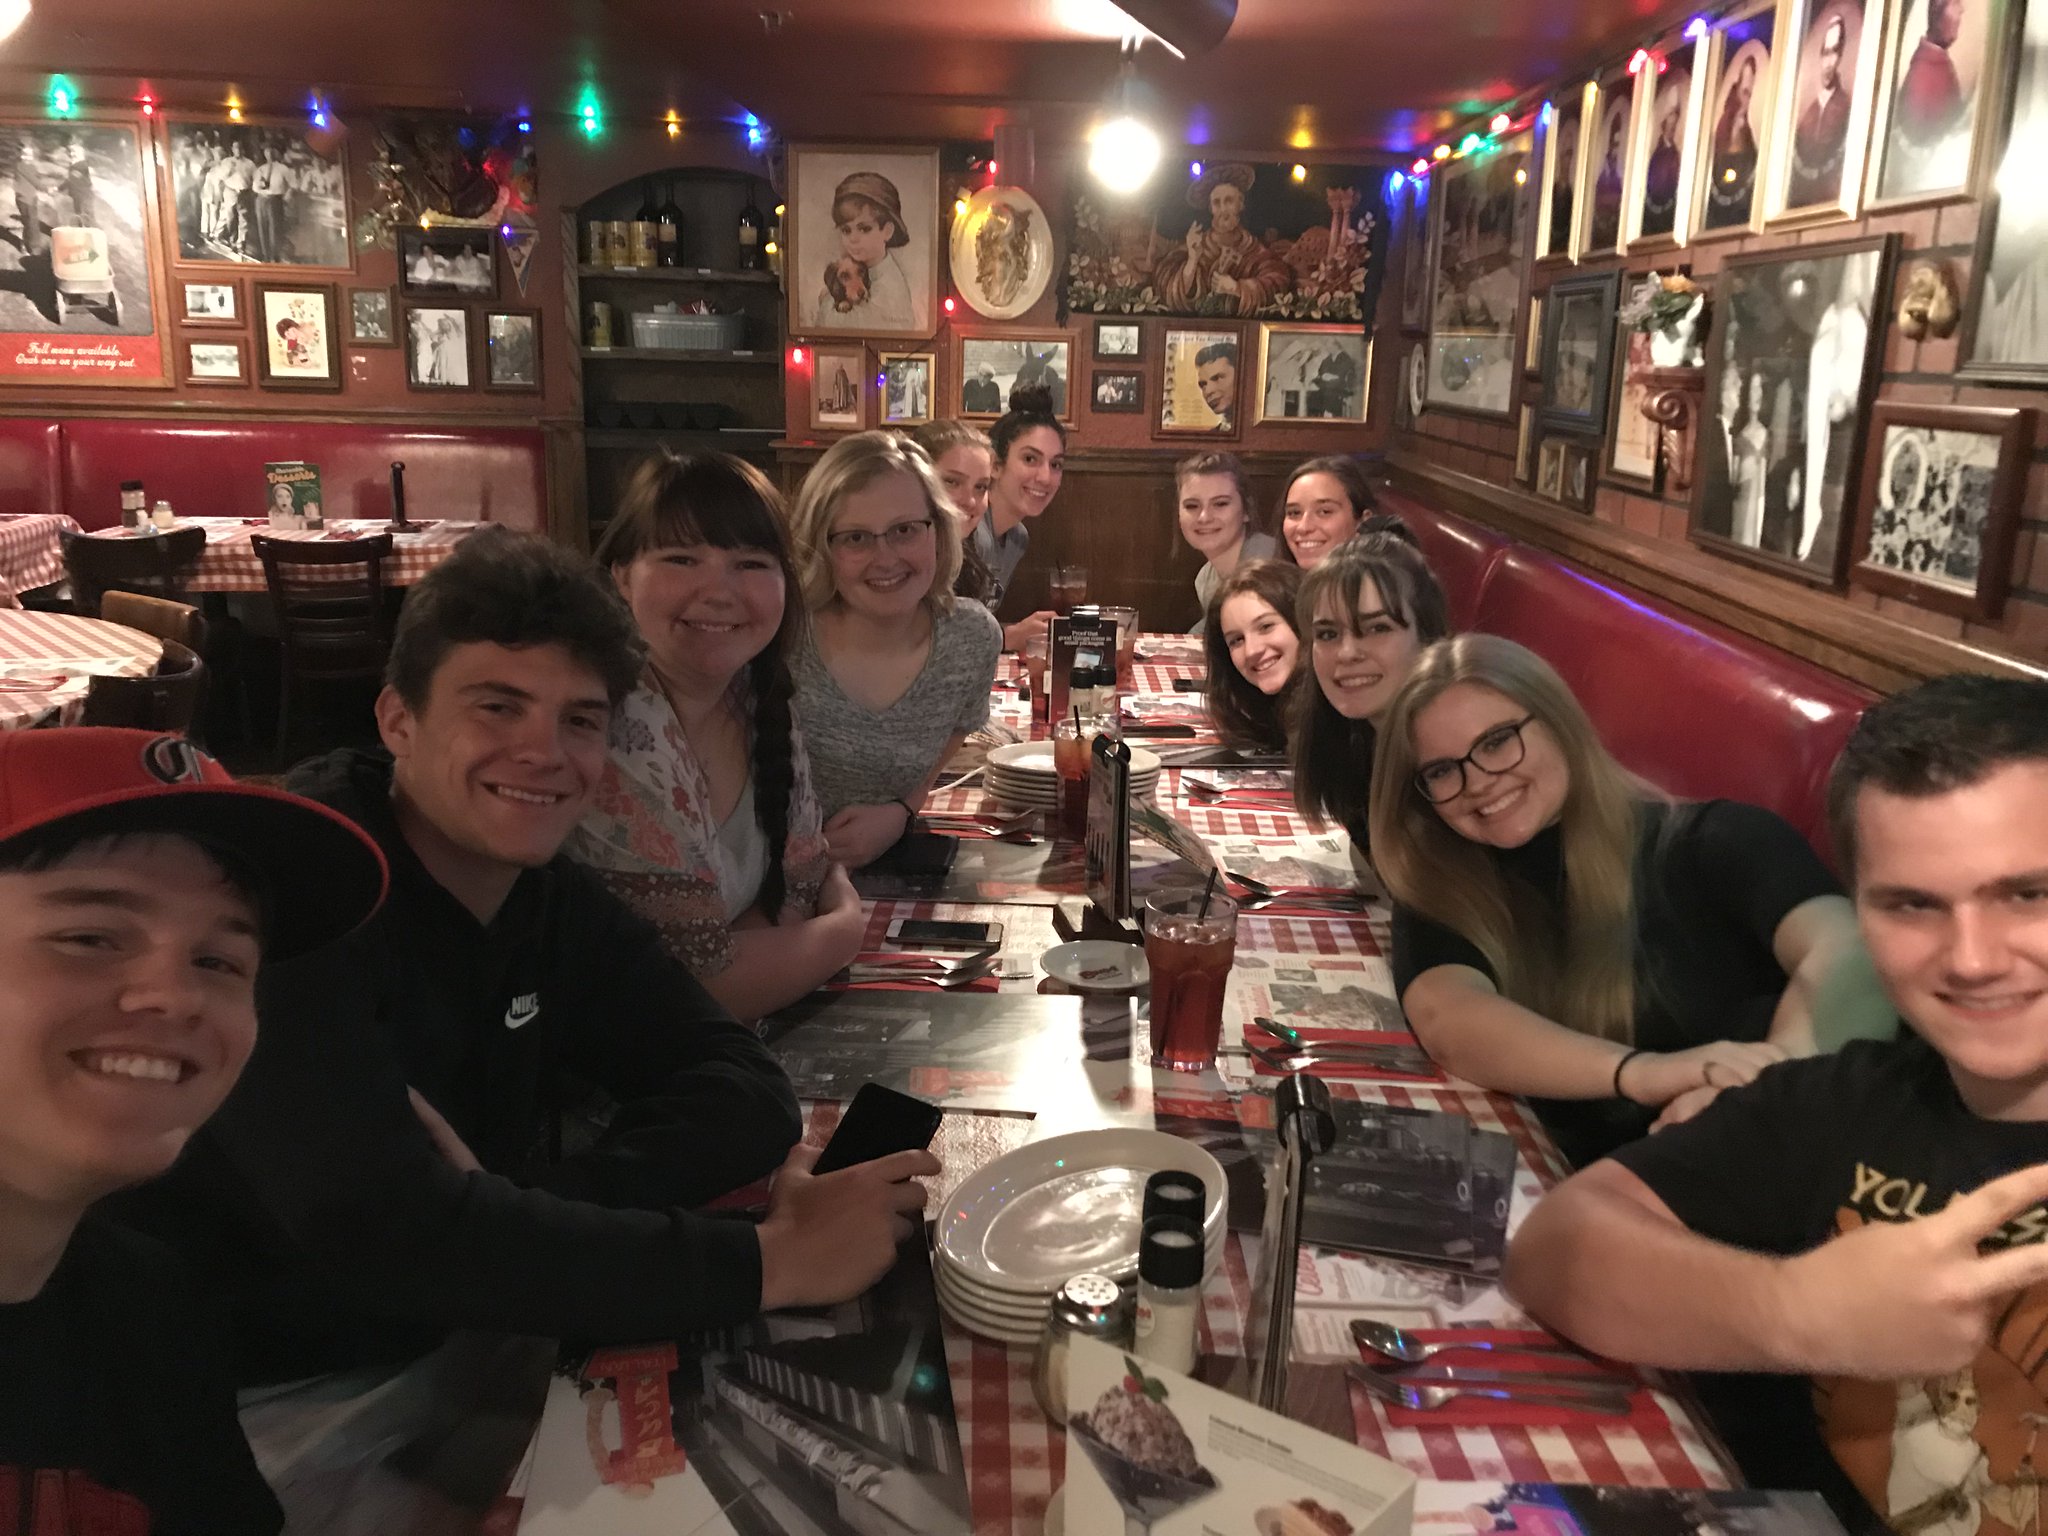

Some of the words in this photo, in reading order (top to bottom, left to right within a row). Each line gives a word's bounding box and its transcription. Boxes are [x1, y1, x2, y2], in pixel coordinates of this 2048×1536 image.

[27, 342, 51, 354] Full
[51, 347, 74, 355] menu
[15, 353, 39, 365] Grab
[72, 359, 95, 370] your
[97, 359, 117, 371] way
[511, 992, 538, 1015] NIKE
